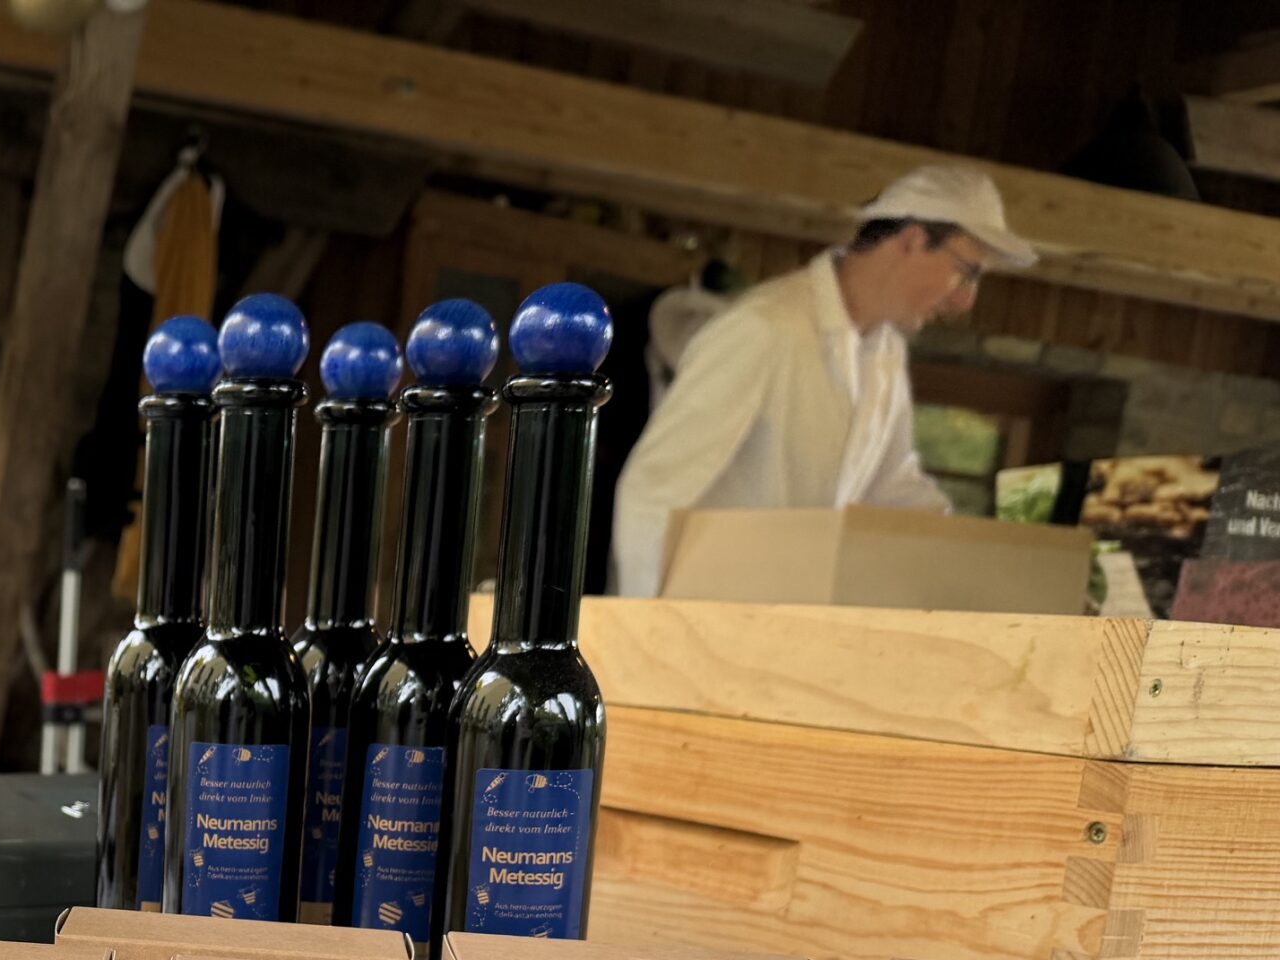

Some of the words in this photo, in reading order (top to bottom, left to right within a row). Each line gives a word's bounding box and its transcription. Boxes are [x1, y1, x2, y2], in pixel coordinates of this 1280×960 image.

[200, 777, 228, 789] Besser
[199, 791, 225, 802] direkt
[227, 795, 248, 803] vom
[487, 806, 521, 817] Besser
[196, 813, 277, 831] Neumanns
[484, 822, 516, 833] direkt
[518, 826, 542, 834] vom
[203, 833, 269, 854] Metessig
[481, 846, 573, 865] Neumanns
[489, 867, 564, 890] Metessig
